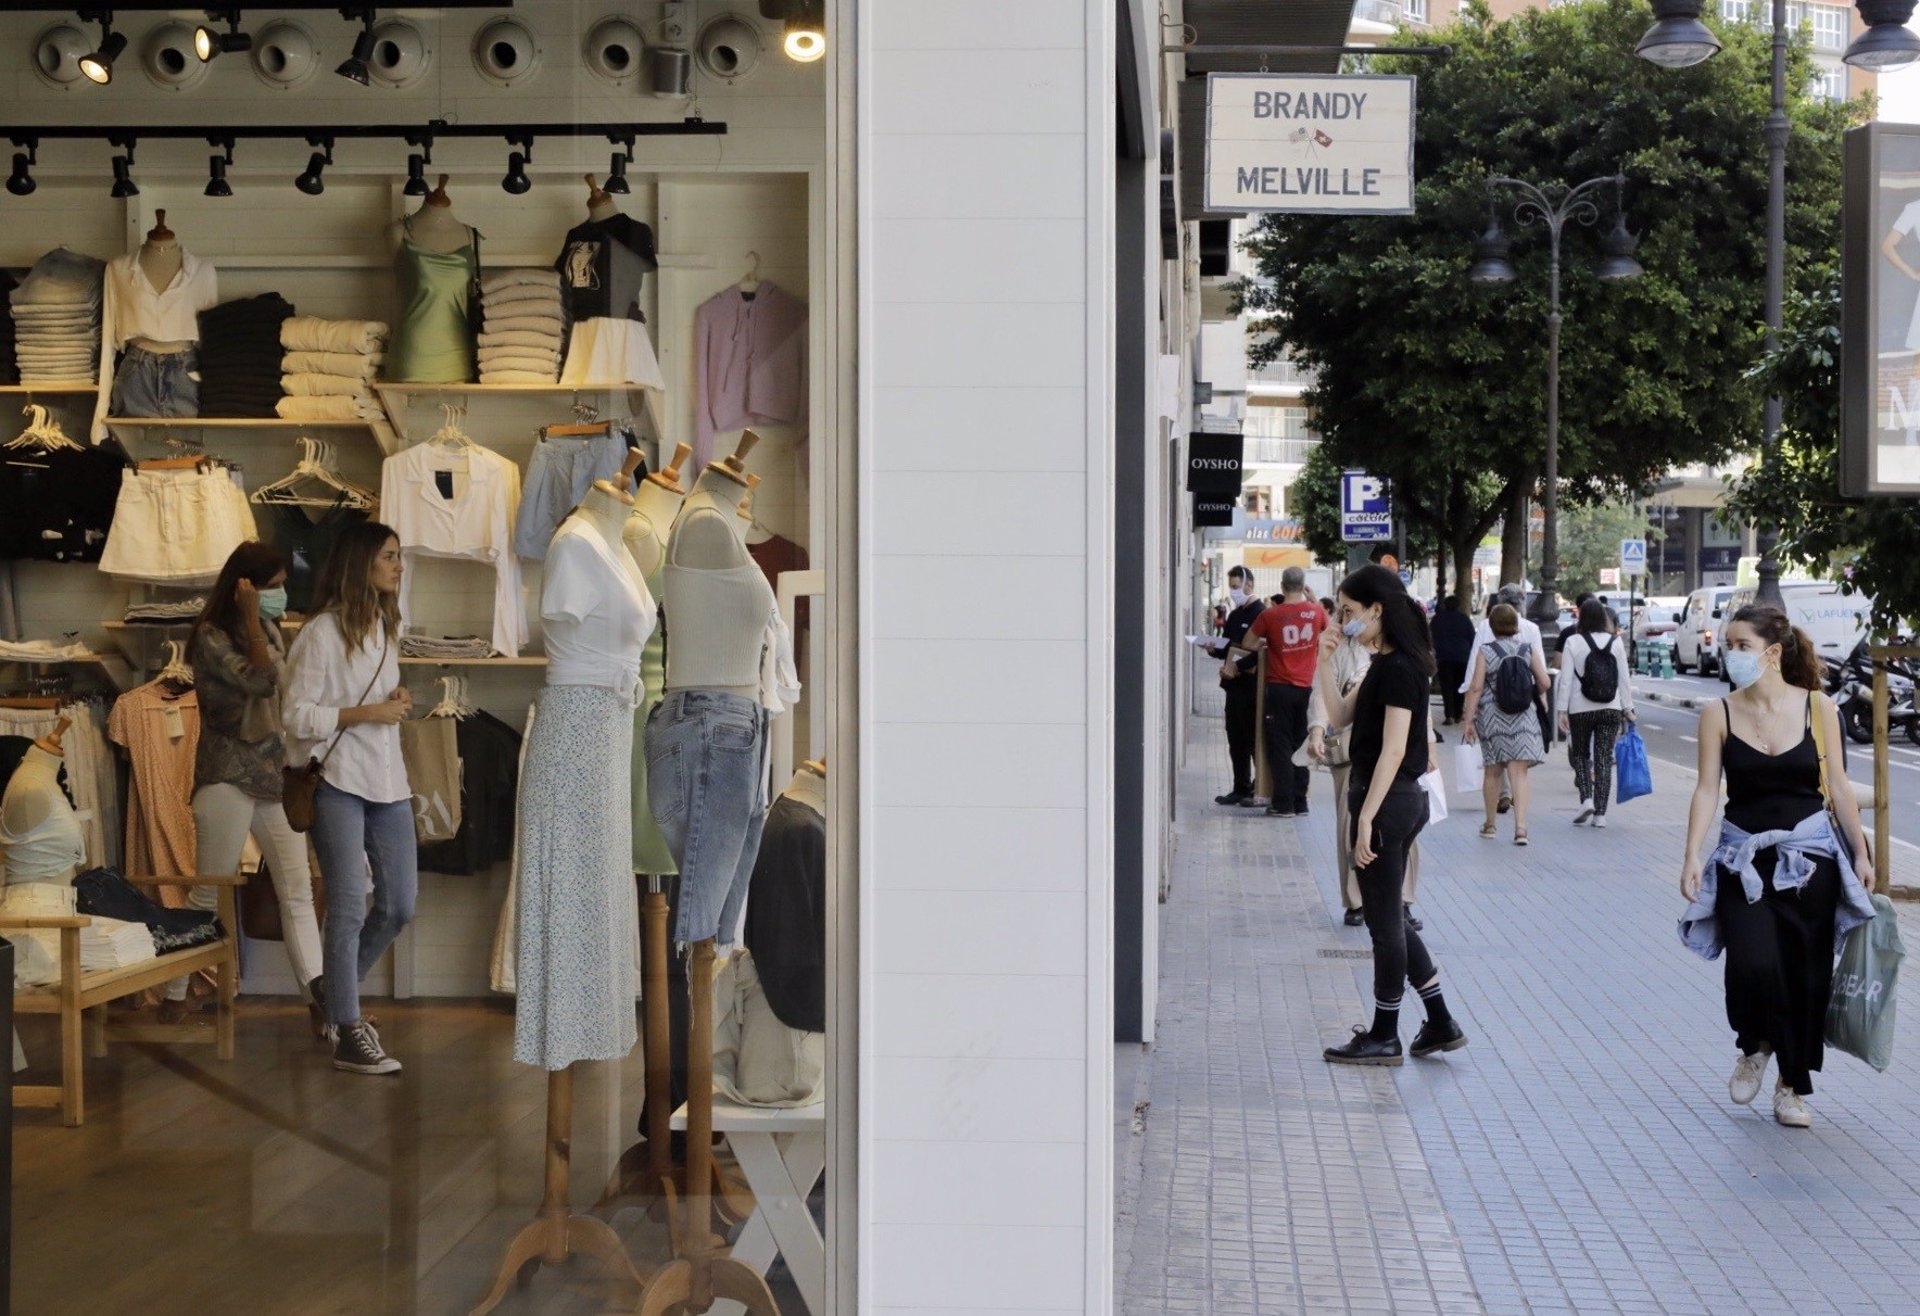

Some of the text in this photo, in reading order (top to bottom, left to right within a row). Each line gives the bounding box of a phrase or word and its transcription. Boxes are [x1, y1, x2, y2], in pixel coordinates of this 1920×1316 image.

[1253, 90, 1368, 120] BRANDY
[1236, 166, 1381, 196] MELVILLE
[1191, 458, 1239, 470] OYSHO
[1350, 476, 1383, 511] P
[1198, 503, 1231, 512] OYSHO
[1282, 623, 1313, 645] 04
